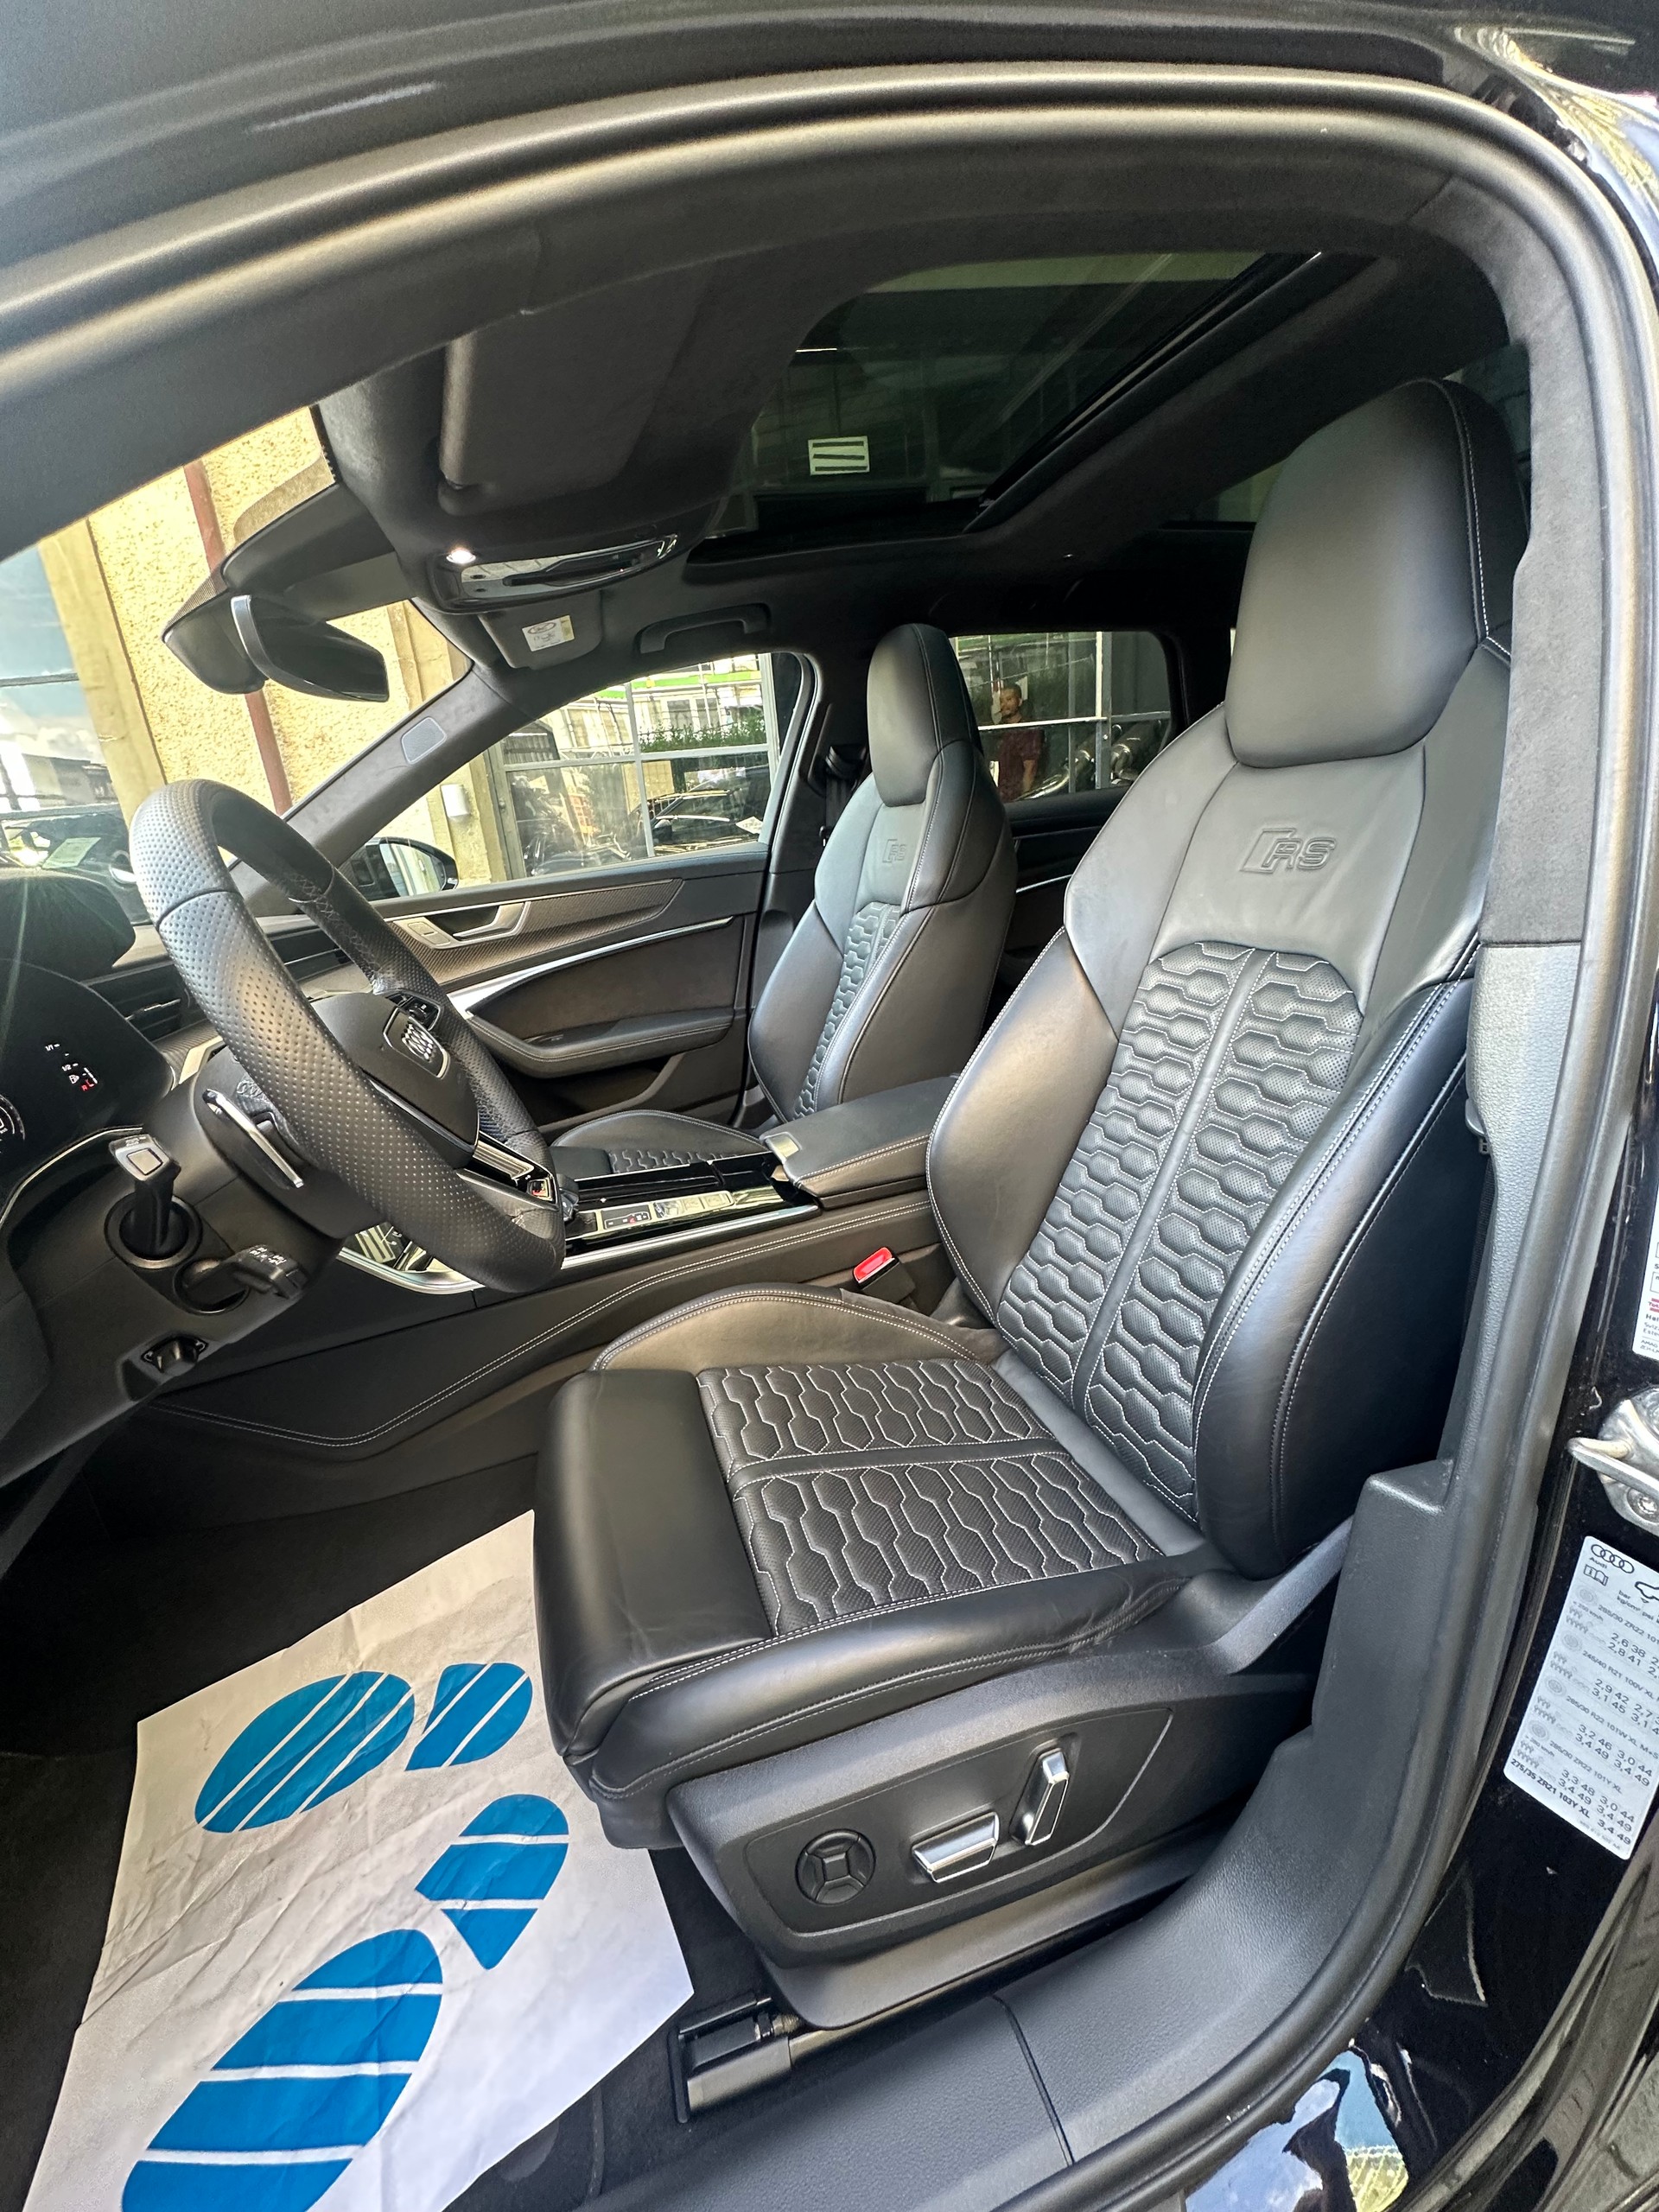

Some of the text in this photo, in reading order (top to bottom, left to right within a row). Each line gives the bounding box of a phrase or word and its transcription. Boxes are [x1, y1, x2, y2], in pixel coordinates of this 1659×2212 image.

[1255, 835, 1337, 872] RS
[1589, 1557, 1607, 1569] Audi
[1618, 1590, 1630, 1599] bar
[1642, 1611, 1654, 1620] psi
[1607, 1642, 1626, 1656] 2,8
[1628, 1656, 1641, 1666] 41
[1611, 1632, 1629, 1648] 2,6
[1630, 1644, 1646, 1657] 38
[1592, 1688, 1608, 1702] 3,1
[1611, 1702, 1626, 1713] 45
[1630, 1713, 1648, 1728] 3,1
[1595, 1679, 1612, 1694] 2,9
[1615, 1692, 1630, 1705] 42
[1634, 1703, 1653, 1718] 2,7
[1575, 1733, 1649, 1786] 3,4 49 3,4 49
[1579, 1724, 1652, 1777] 3,2 46 3,0 44
[1558, 1778, 1632, 1832] 3,4 49 3,4 49
[1561, 1770, 1634, 1822] 3,3 48 3,0 44
[1598, 1819, 1614, 1834] 3,4
[1617, 1834, 1631, 1845] 49
